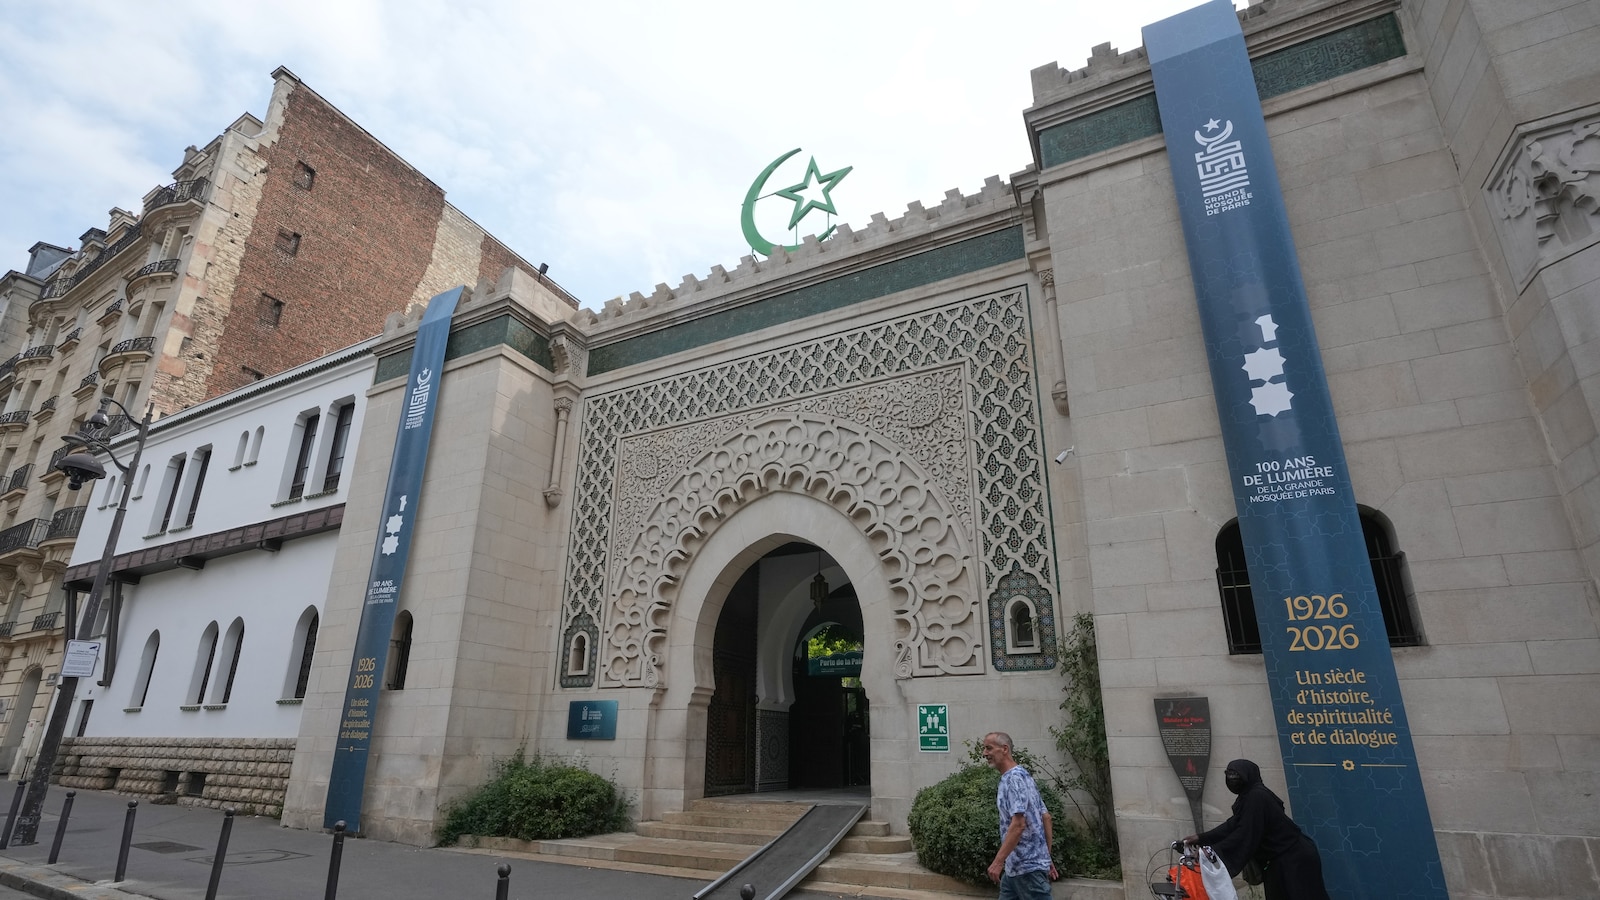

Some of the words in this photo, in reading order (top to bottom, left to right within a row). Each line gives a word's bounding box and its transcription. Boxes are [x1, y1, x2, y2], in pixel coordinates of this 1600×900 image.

[1204, 188, 1246, 204] GRANDE
[1205, 192, 1253, 210] MOSQUÉE
[1206, 208, 1219, 216] DE
[1222, 200, 1250, 212] PARIS
[1256, 461, 1280, 472] 100
[1284, 456, 1316, 470] ANS
[1243, 474, 1263, 486] DE
[1267, 466, 1334, 484] LUMIÈRE
[1250, 492, 1294, 503] MOSQUÉE
[1295, 490, 1308, 498] DE
[1309, 487, 1335, 496] PARIS
[1257, 486, 1269, 494] DE
[1285, 480, 1324, 491] GRANDE
[1284, 594, 1348, 620] 1926
[1287, 624, 1360, 652] 2026
[358, 658, 376, 672] 1926
[353, 674, 374, 688] 2026
[1296, 670, 1322, 685] Un
[1325, 668, 1366, 684] siècle
[1297, 689, 1374, 705] d’histoire,
[1287, 709, 1305, 724] de
[1308, 708, 1393, 727] spiritualité
[1291, 732, 1306, 745] et
[1308, 730, 1327, 745] de
[1330, 729, 1398, 748] dialogue
